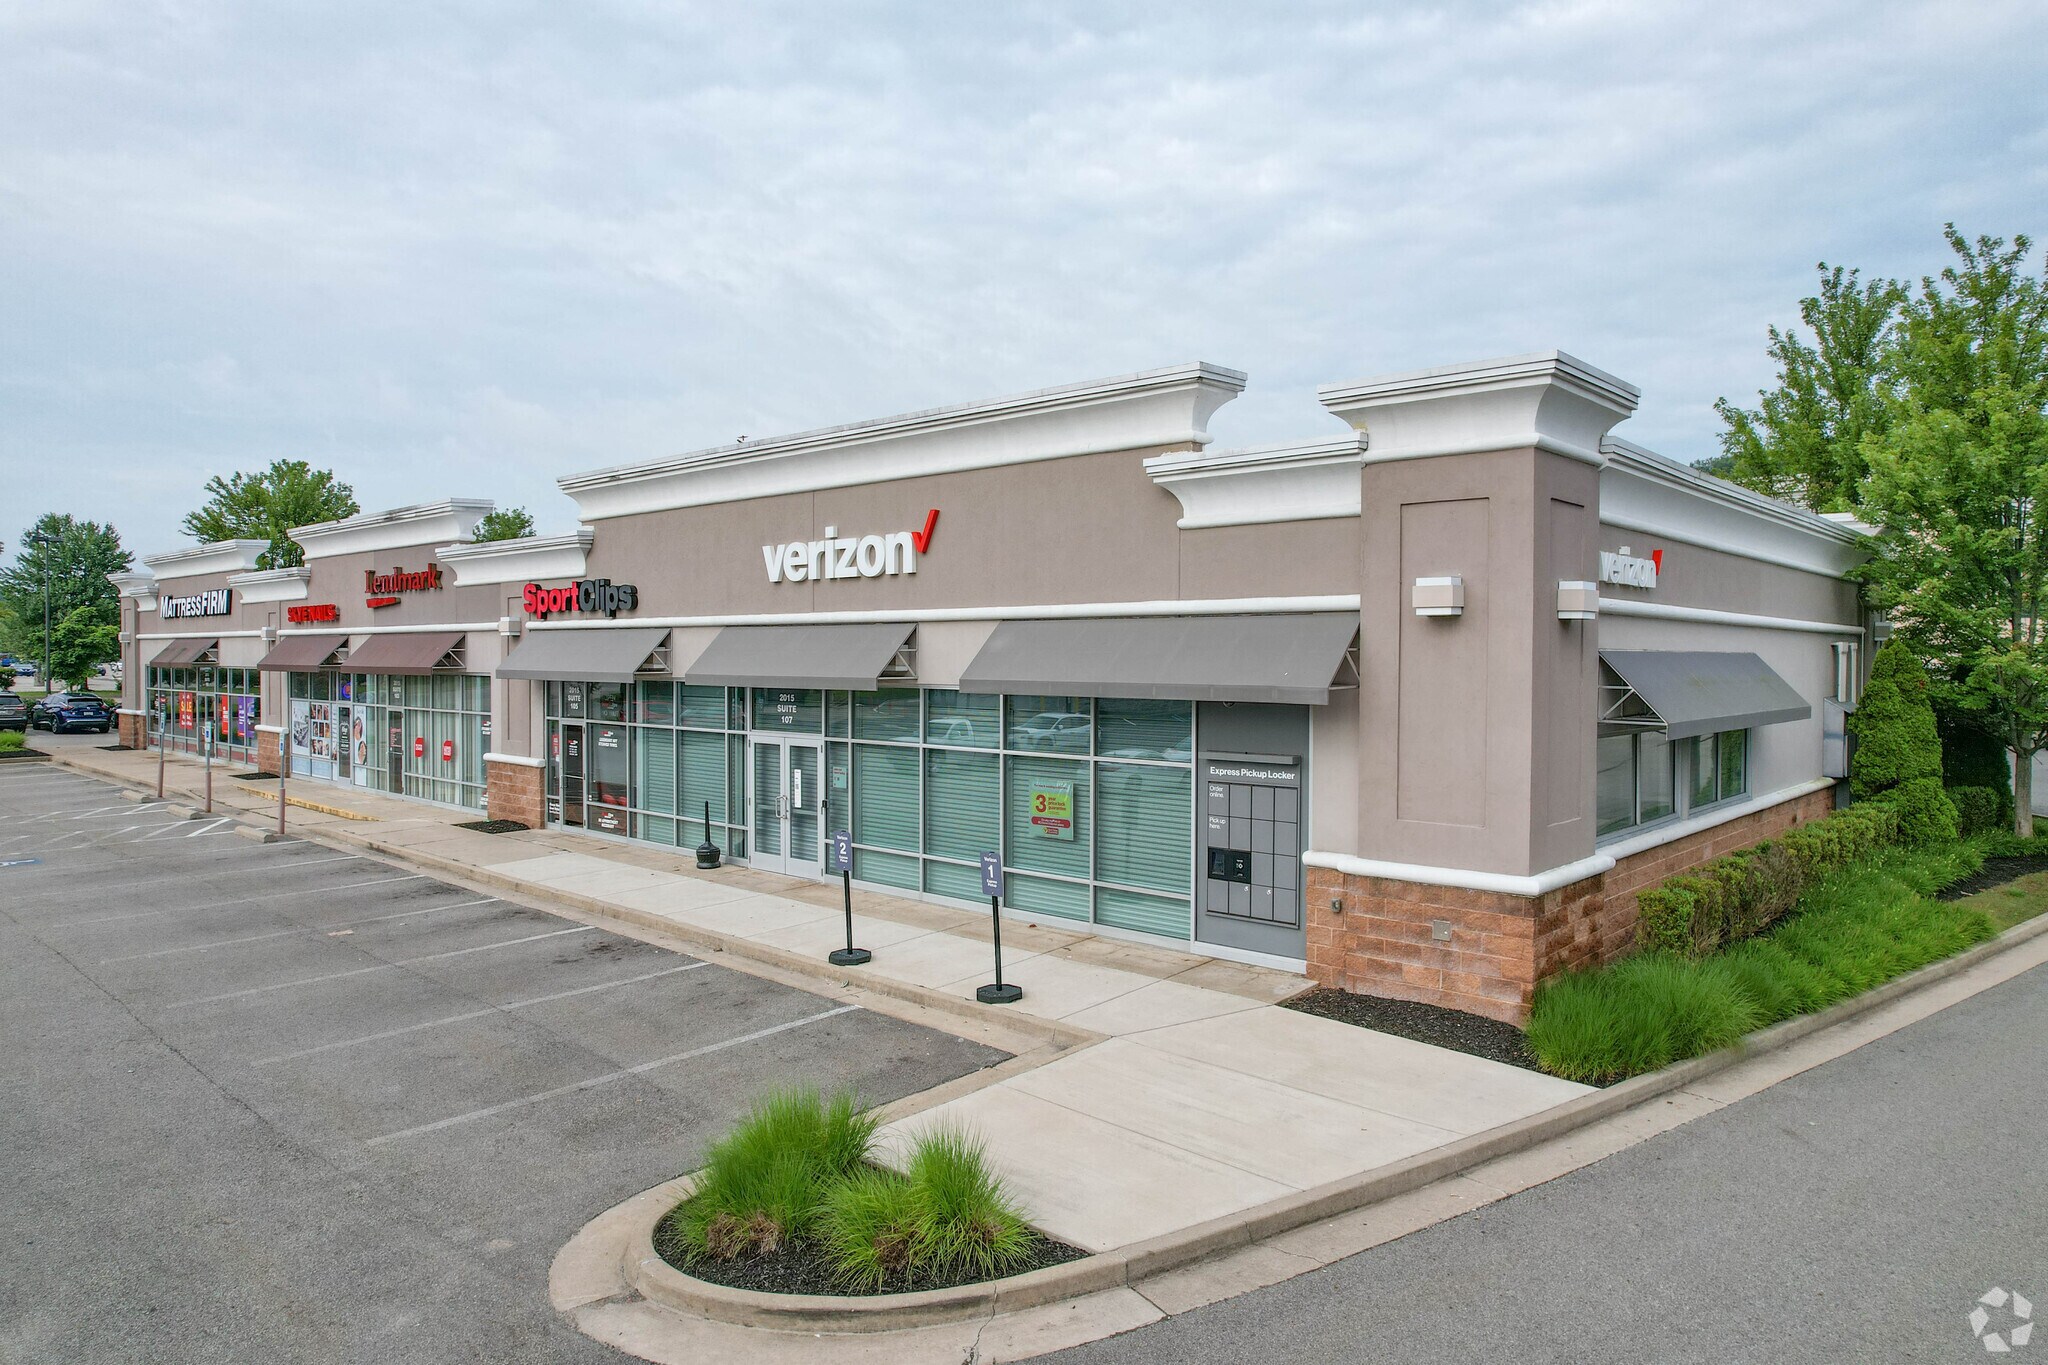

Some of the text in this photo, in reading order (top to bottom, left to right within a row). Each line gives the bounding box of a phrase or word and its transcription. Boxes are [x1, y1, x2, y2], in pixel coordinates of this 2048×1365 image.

[762, 526, 917, 582] verizon
[1599, 546, 1657, 588] verizon
[365, 563, 443, 594] Lendmark
[567, 694, 582, 702] SUITE
[779, 693, 795, 702] 2015
[180, 701, 193, 712] SLE
[777, 704, 797, 713] SUITE
[781, 715, 793, 724] 107
[1210, 767, 1295, 780] Express Pickup Locker
[1036, 794, 1046, 812] 3
[840, 842, 846, 854] 2
[988, 865, 994, 878] 1
